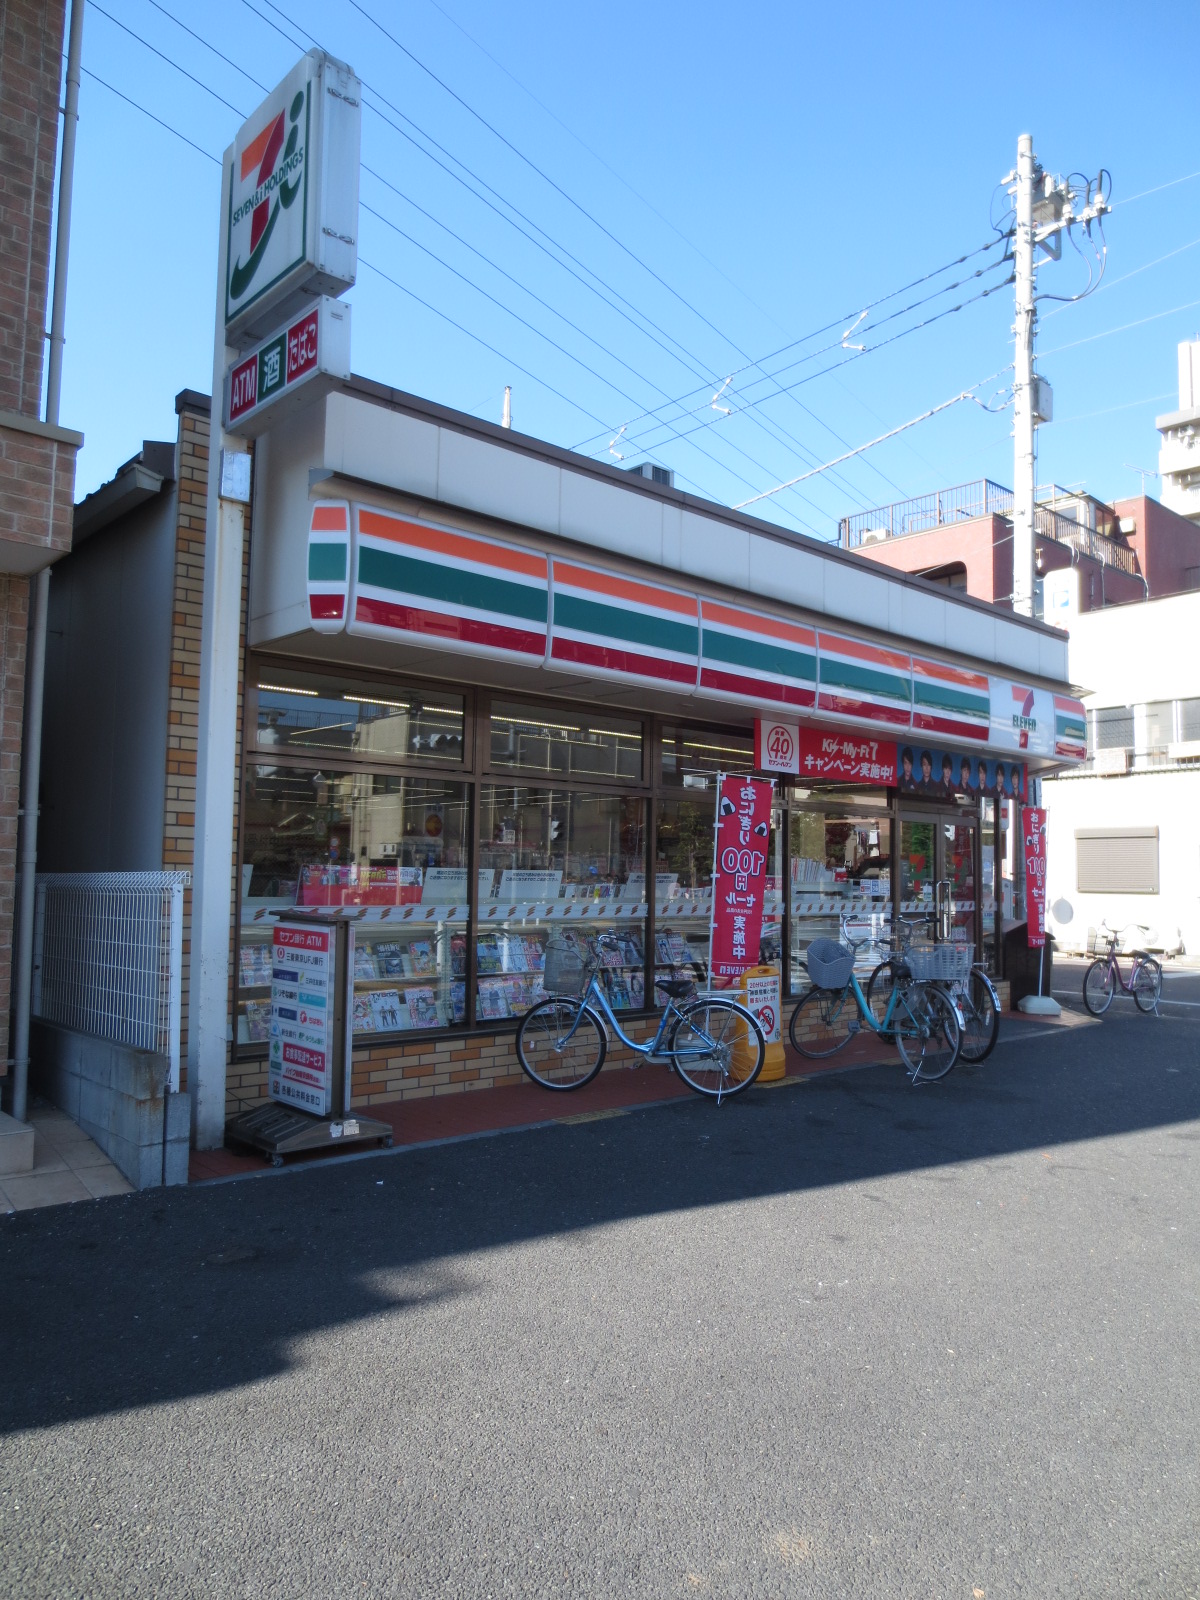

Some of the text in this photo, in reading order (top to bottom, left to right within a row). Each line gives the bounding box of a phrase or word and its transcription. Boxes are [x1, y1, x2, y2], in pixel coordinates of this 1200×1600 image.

[264, 147, 304, 198] HOLDINGS
[263, 345, 282, 393] 酒
[288, 322, 317, 374] たばこ
[232, 364, 257, 412] ATM
[770, 736, 790, 760] 40
[1030, 812, 1040, 855] おにぎり
[280, 931, 322, 947] セブン銀行 ATM
